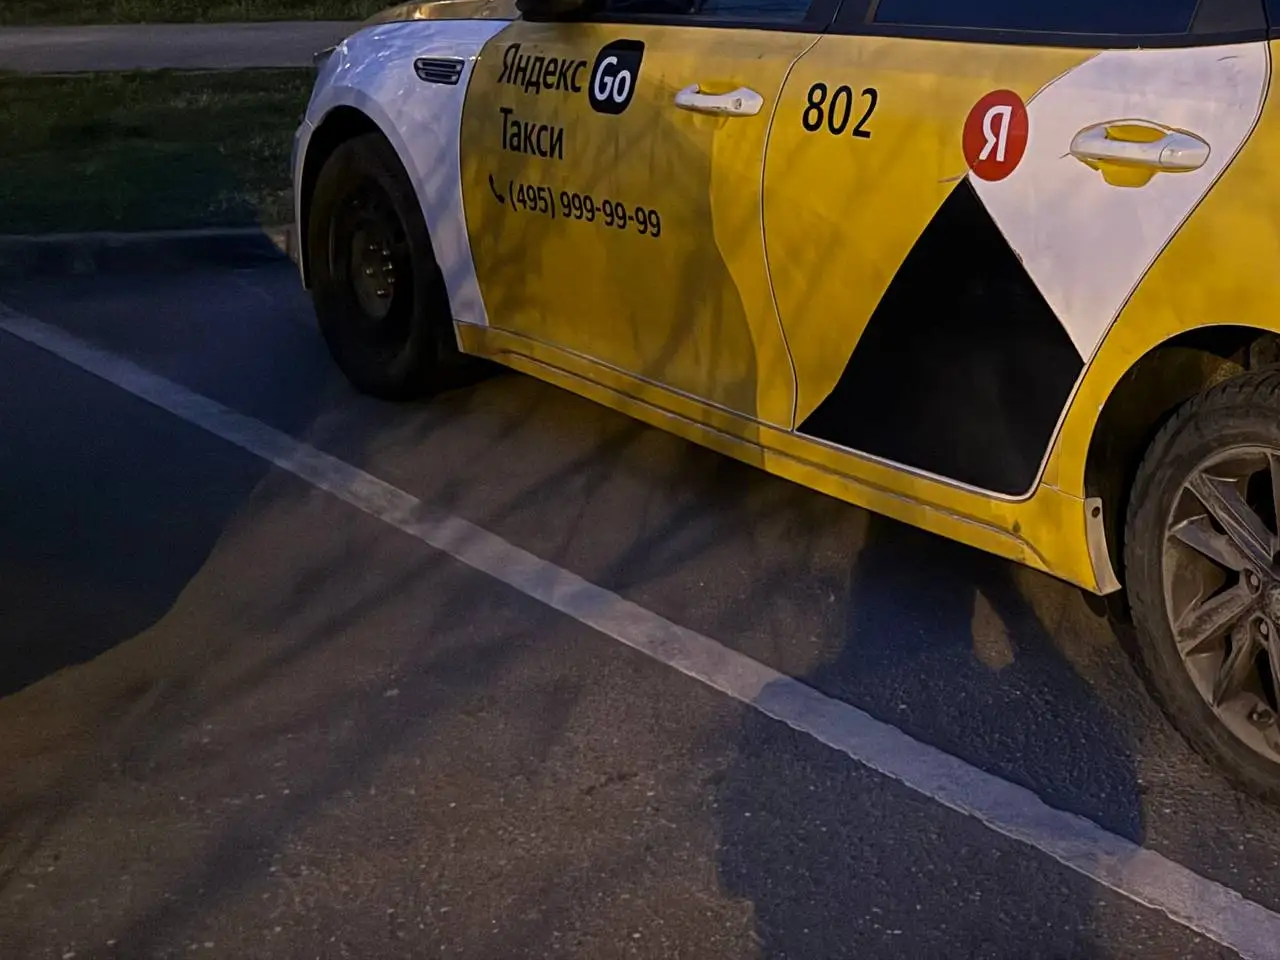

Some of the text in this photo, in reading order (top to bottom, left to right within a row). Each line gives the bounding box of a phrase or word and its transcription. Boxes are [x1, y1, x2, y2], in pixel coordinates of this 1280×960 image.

[497, 43, 632, 103] Яндекс Go
[499, 107, 564, 160] Такси
[802, 82, 878, 138] 802
[979, 105, 1012, 162] Я
[509, 180, 661, 238] (495) 999-99-99
